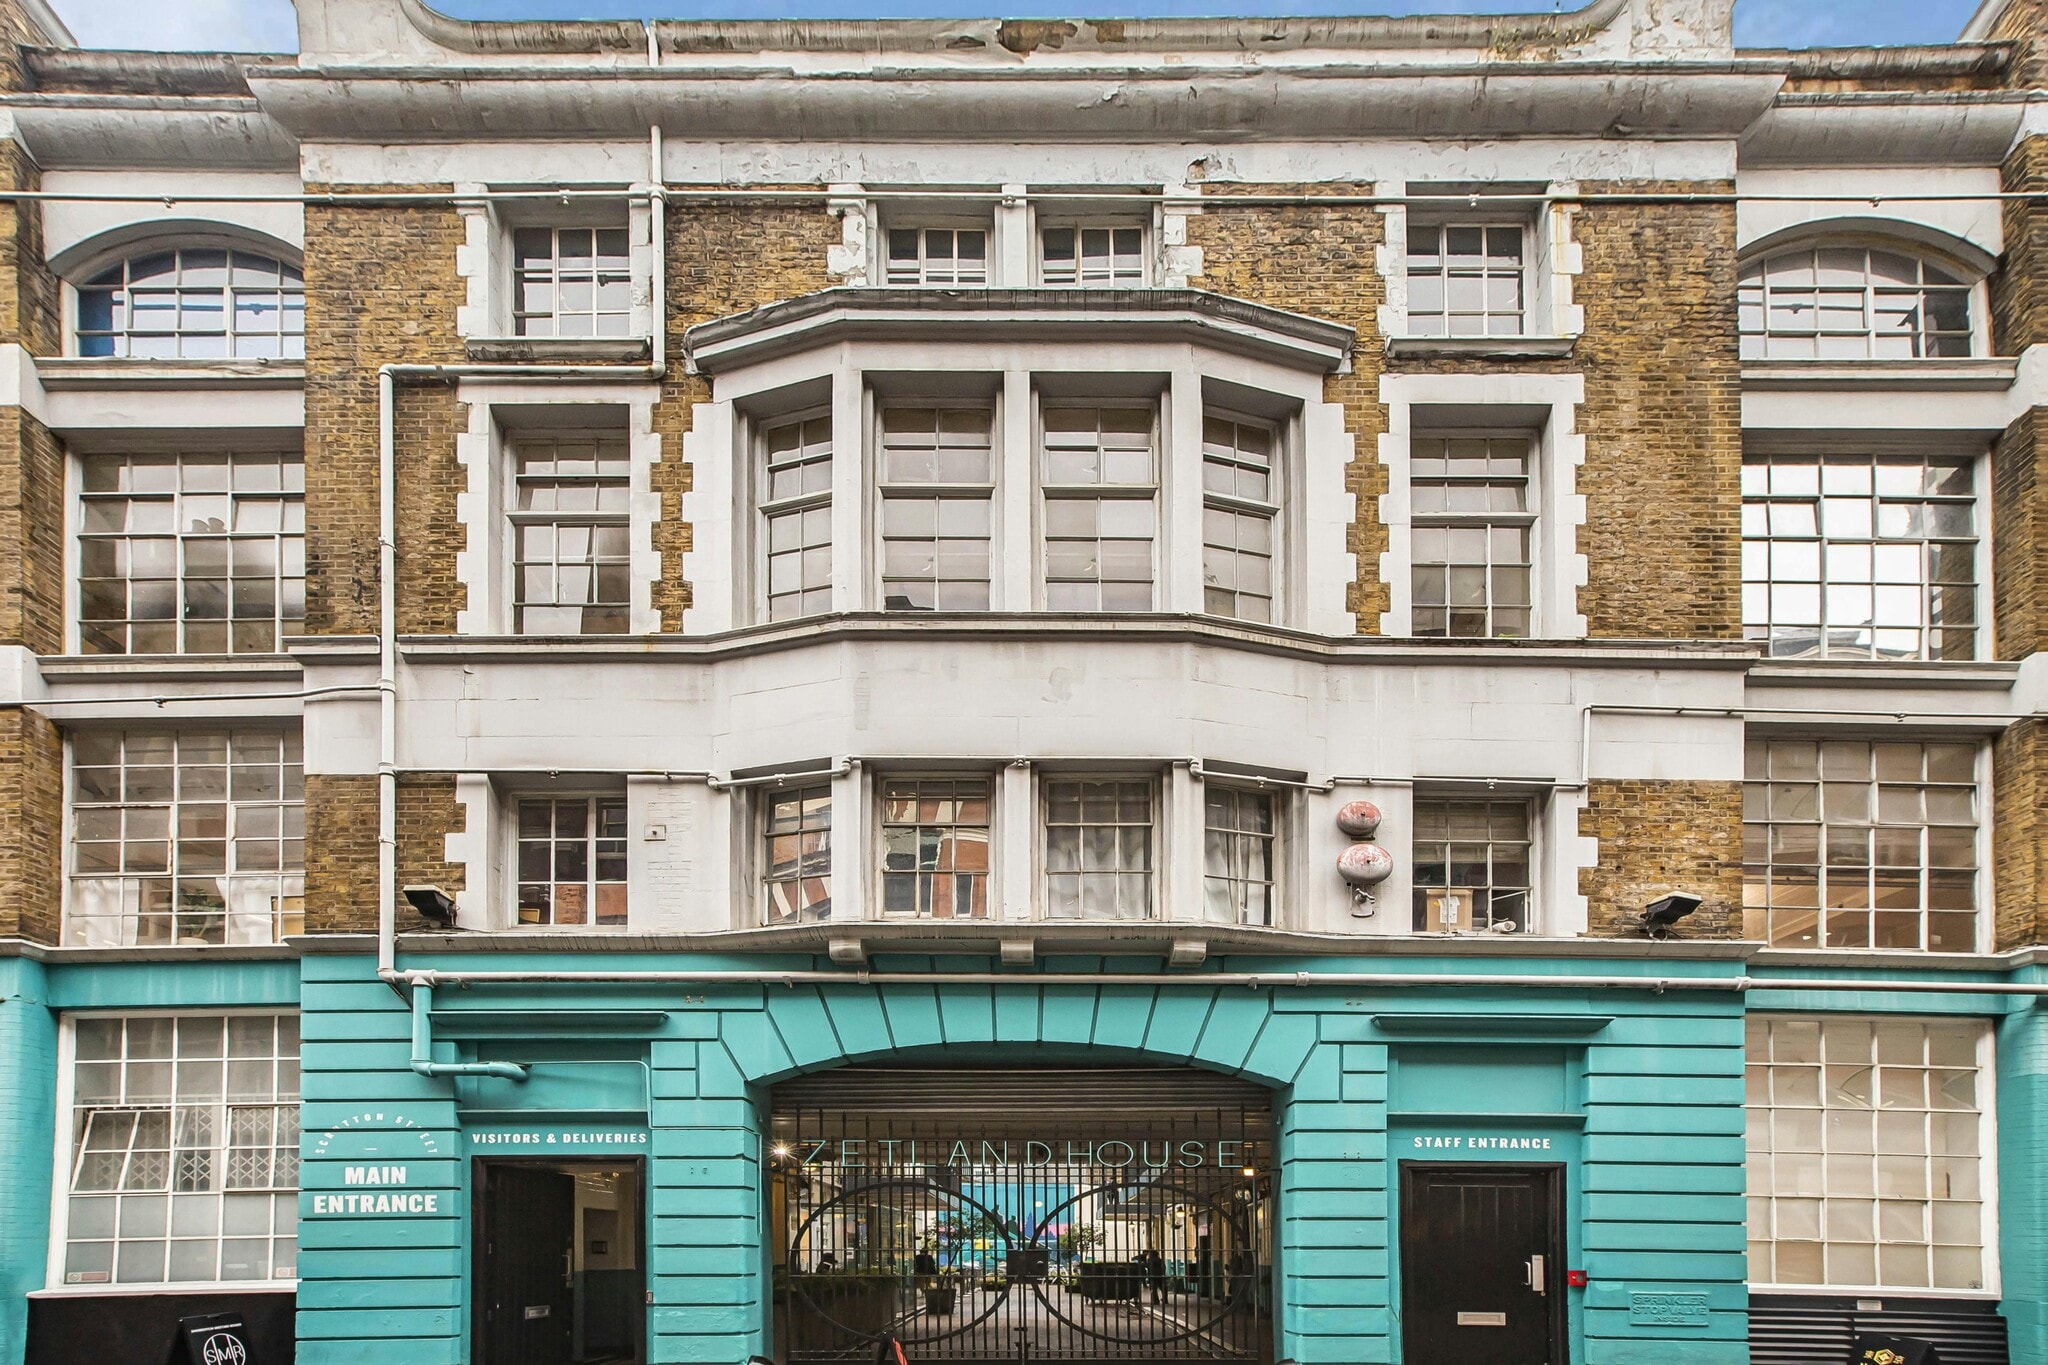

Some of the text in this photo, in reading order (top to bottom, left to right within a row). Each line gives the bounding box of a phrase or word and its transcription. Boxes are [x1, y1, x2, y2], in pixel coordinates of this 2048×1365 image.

[395, 1115, 438, 1153] STEET
[472, 1133, 647, 1143] VISITORS & DELIVERIES
[1414, 1137, 1551, 1149] STAFF ENTRANCE
[802, 1140, 1244, 1168] ZETLAND HOUSE
[344, 1166, 406, 1184] MAIN
[313, 1194, 437, 1213] ENTRANCE
[1632, 1295, 1707, 1305] SPRINKLER
[206, 1345, 243, 1363] SMR
